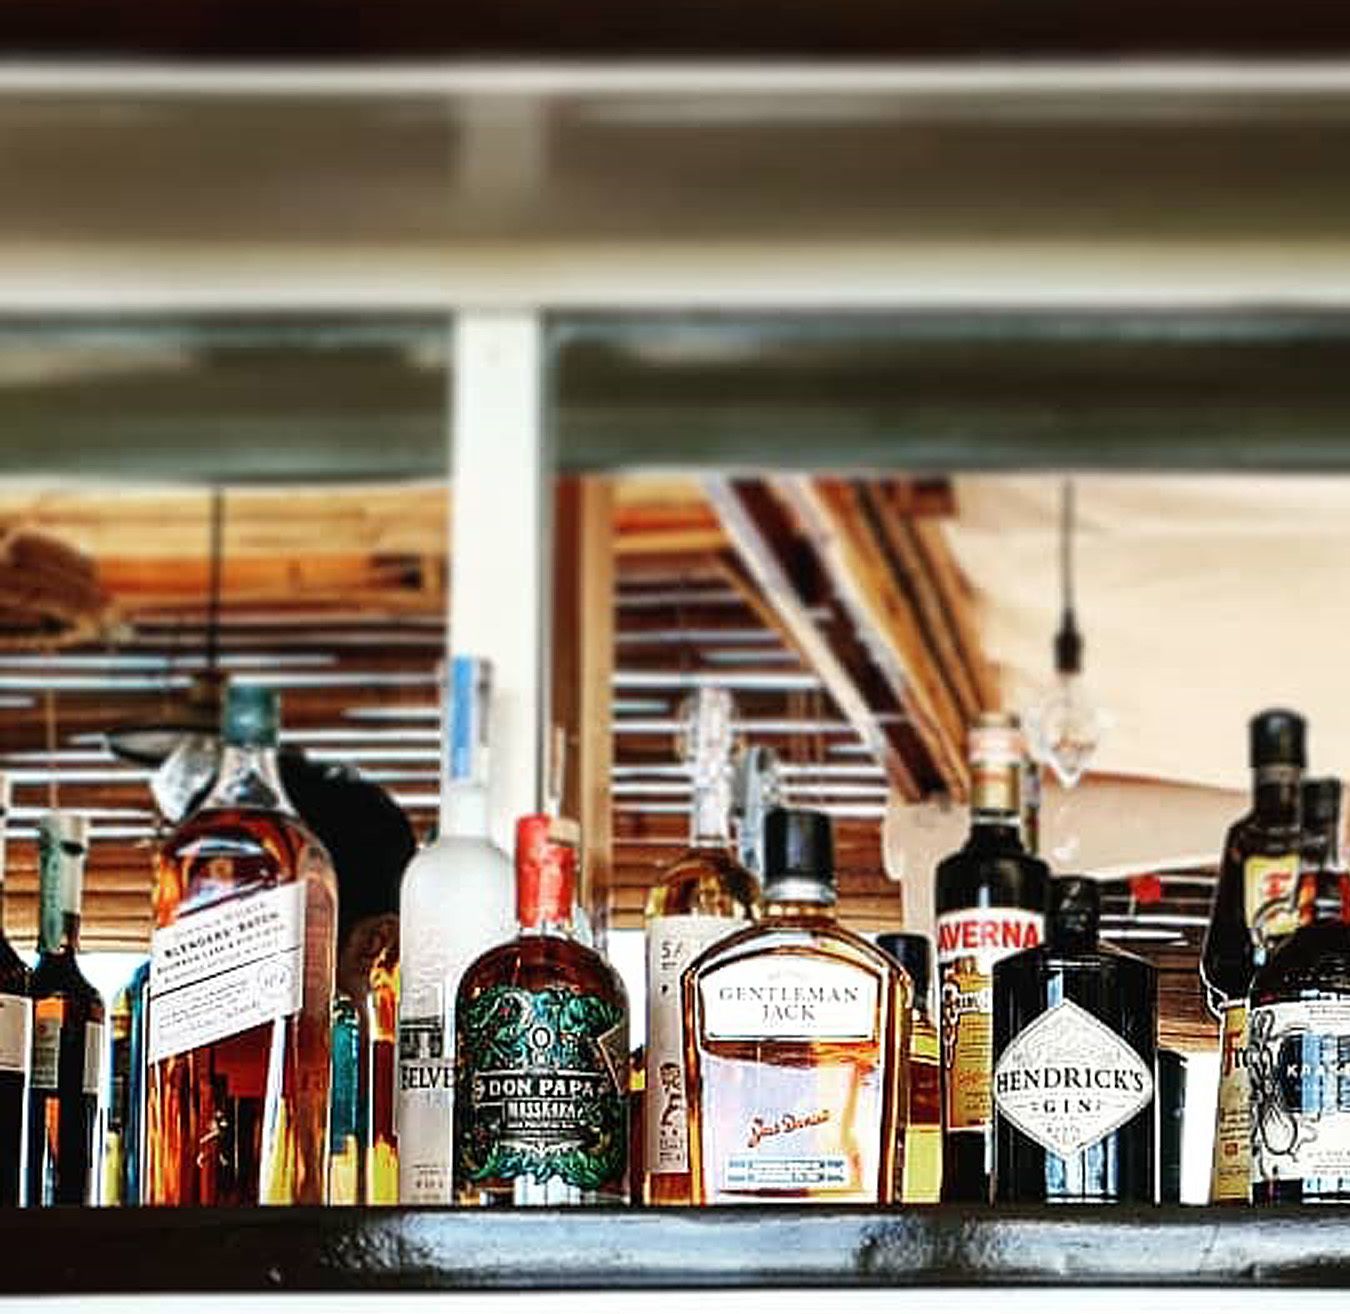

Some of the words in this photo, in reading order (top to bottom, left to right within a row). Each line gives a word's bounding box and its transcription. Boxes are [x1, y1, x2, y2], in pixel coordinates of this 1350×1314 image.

[938, 921, 1041, 951] AVERNA
[719, 987, 860, 1004] GENTLEMAN
[761, 1004, 817, 1022] JACK
[489, 1079, 532, 1097] DON
[538, 1079, 594, 1098] PAPA
[996, 1067, 1145, 1094] HENDRICK'S
[1043, 1099, 1092, 1114] GIN
